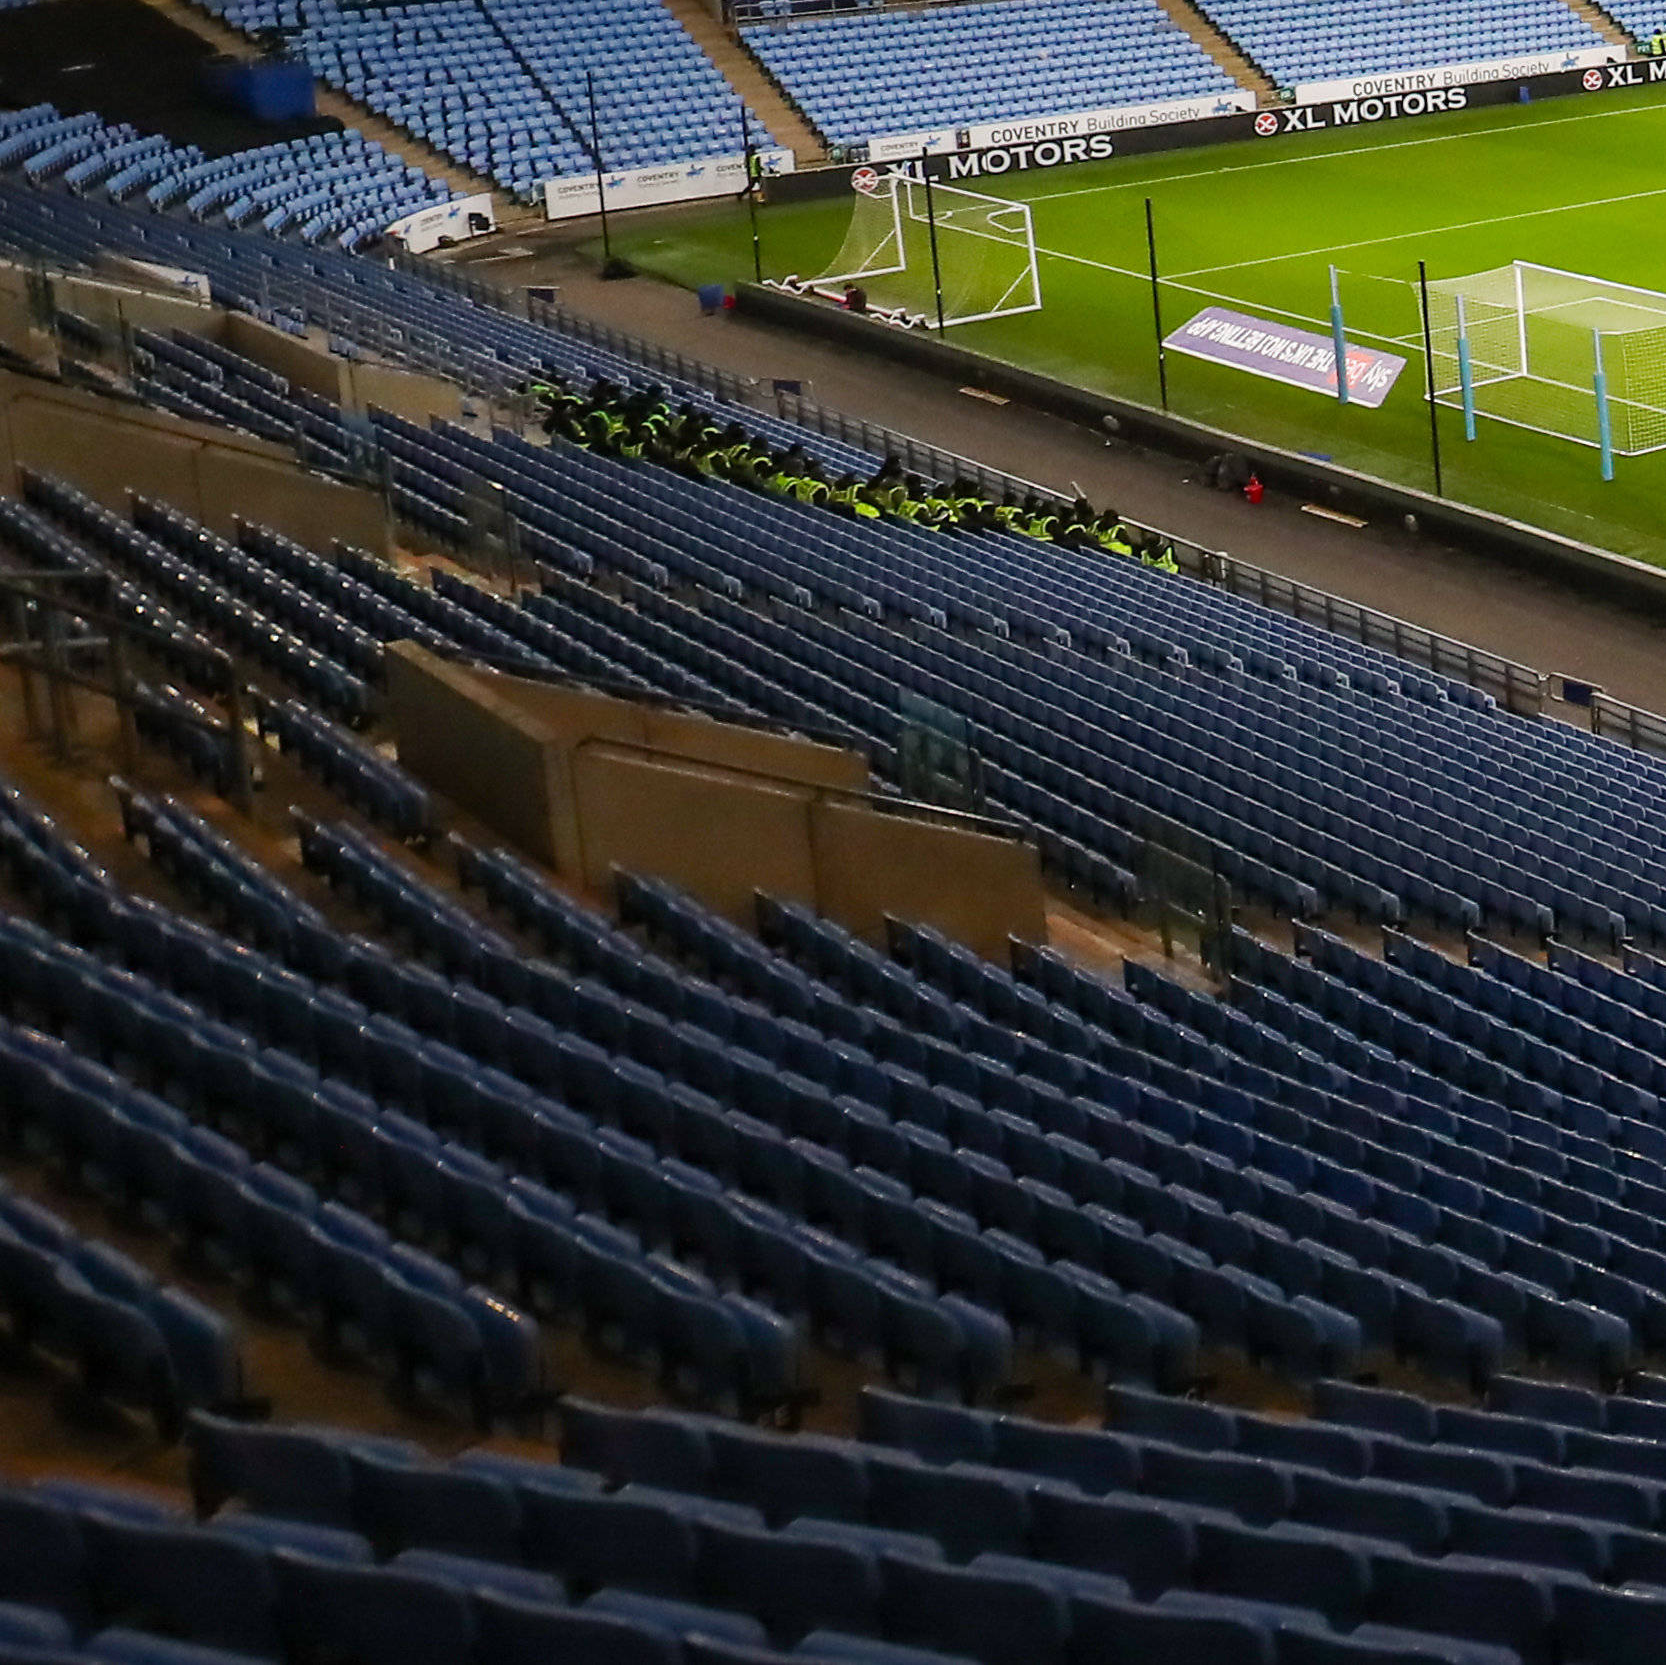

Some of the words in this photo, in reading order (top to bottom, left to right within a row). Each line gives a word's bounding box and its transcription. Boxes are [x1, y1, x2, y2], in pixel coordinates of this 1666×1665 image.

[1352, 74, 1435, 97] COVENTRY
[1607, 66, 1643, 88] XL
[1282, 105, 1327, 133] XL
[1333, 87, 1467, 125] MOTORS
[991, 120, 1079, 145] COVENTRY
[948, 134, 1114, 180] MOTORS
[1187, 317, 1219, 337] APP
[1306, 347, 1336, 373] THE
[1360, 359, 1393, 392] sky
